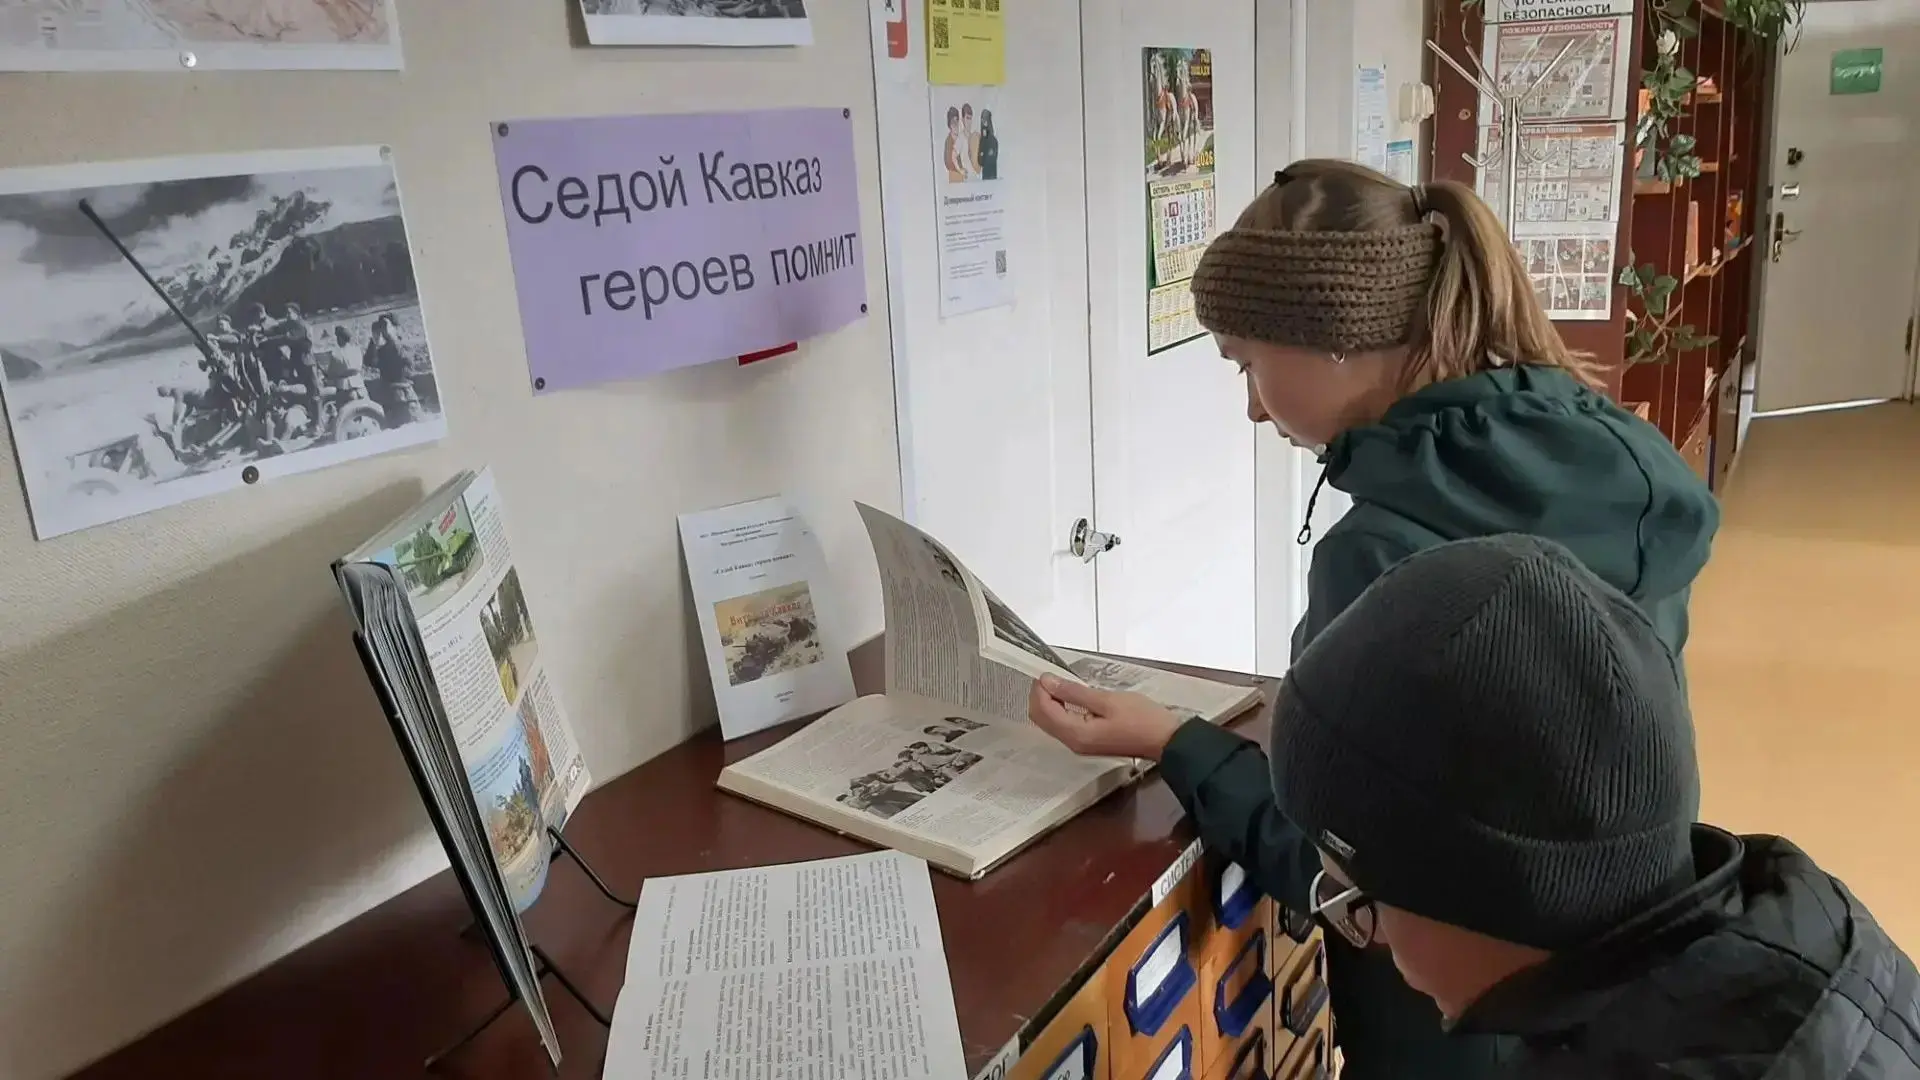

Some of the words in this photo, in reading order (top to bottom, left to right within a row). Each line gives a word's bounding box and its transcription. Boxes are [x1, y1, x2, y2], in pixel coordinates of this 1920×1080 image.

[1504, 4, 1611, 20] БЕЗОПАСНОСТИ
[511, 154, 688, 227] Седой
[698, 150, 823, 204] Кавказ
[579, 252, 755, 320] героев
[771, 232, 857, 286] помнит
[982, 1052, 1009, 1080] ОГ
